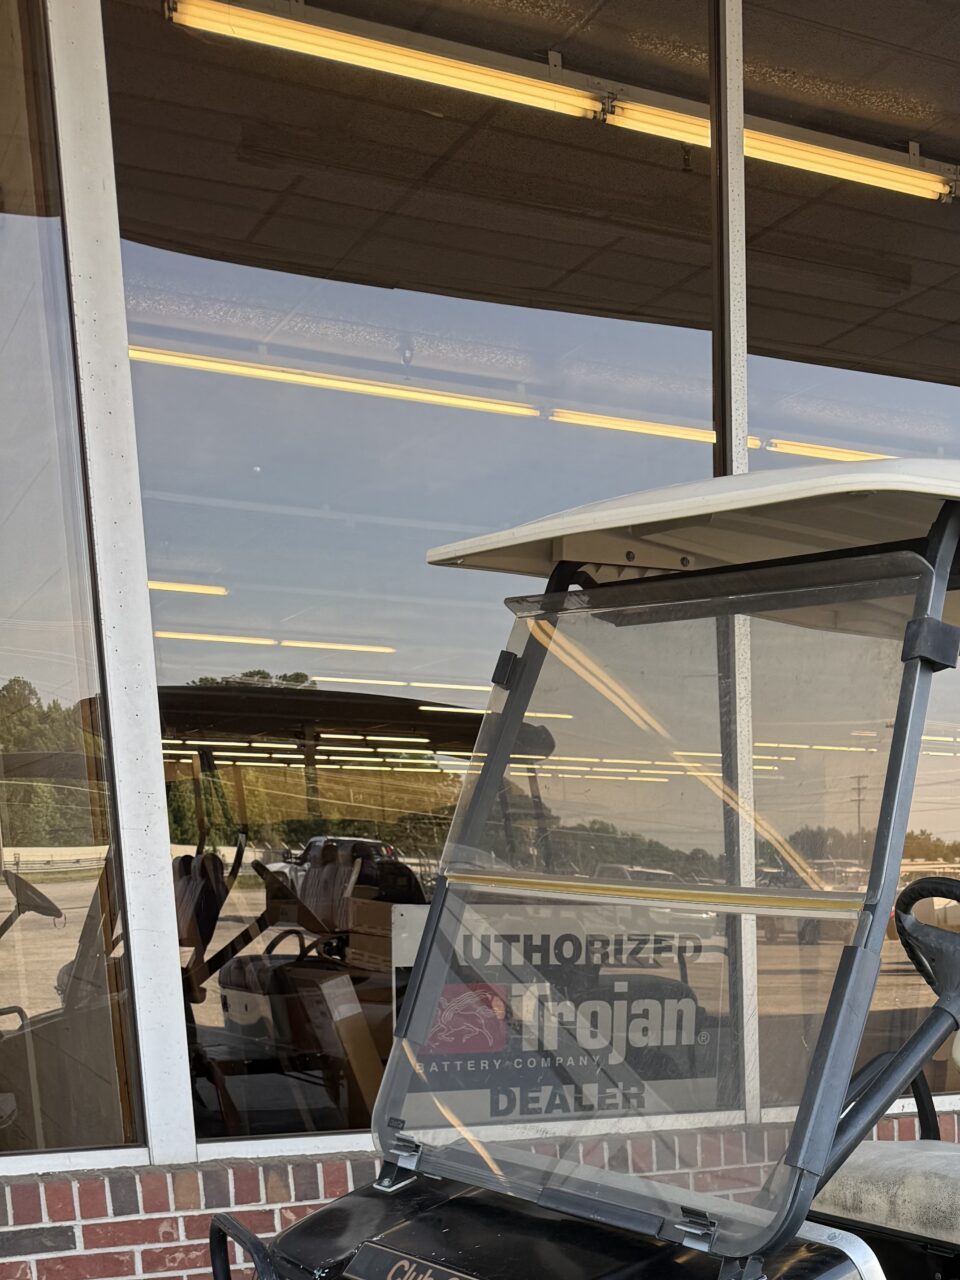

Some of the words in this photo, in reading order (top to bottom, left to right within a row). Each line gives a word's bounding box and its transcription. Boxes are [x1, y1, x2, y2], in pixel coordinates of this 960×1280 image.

[452, 933, 702, 966] UTHORIZED
[511, 981, 697, 1065] Trojan
[416, 1058, 501, 1073] BATTERY
[514, 1055, 600, 1070] COMPANY
[489, 1082, 646, 1118] DEALER
